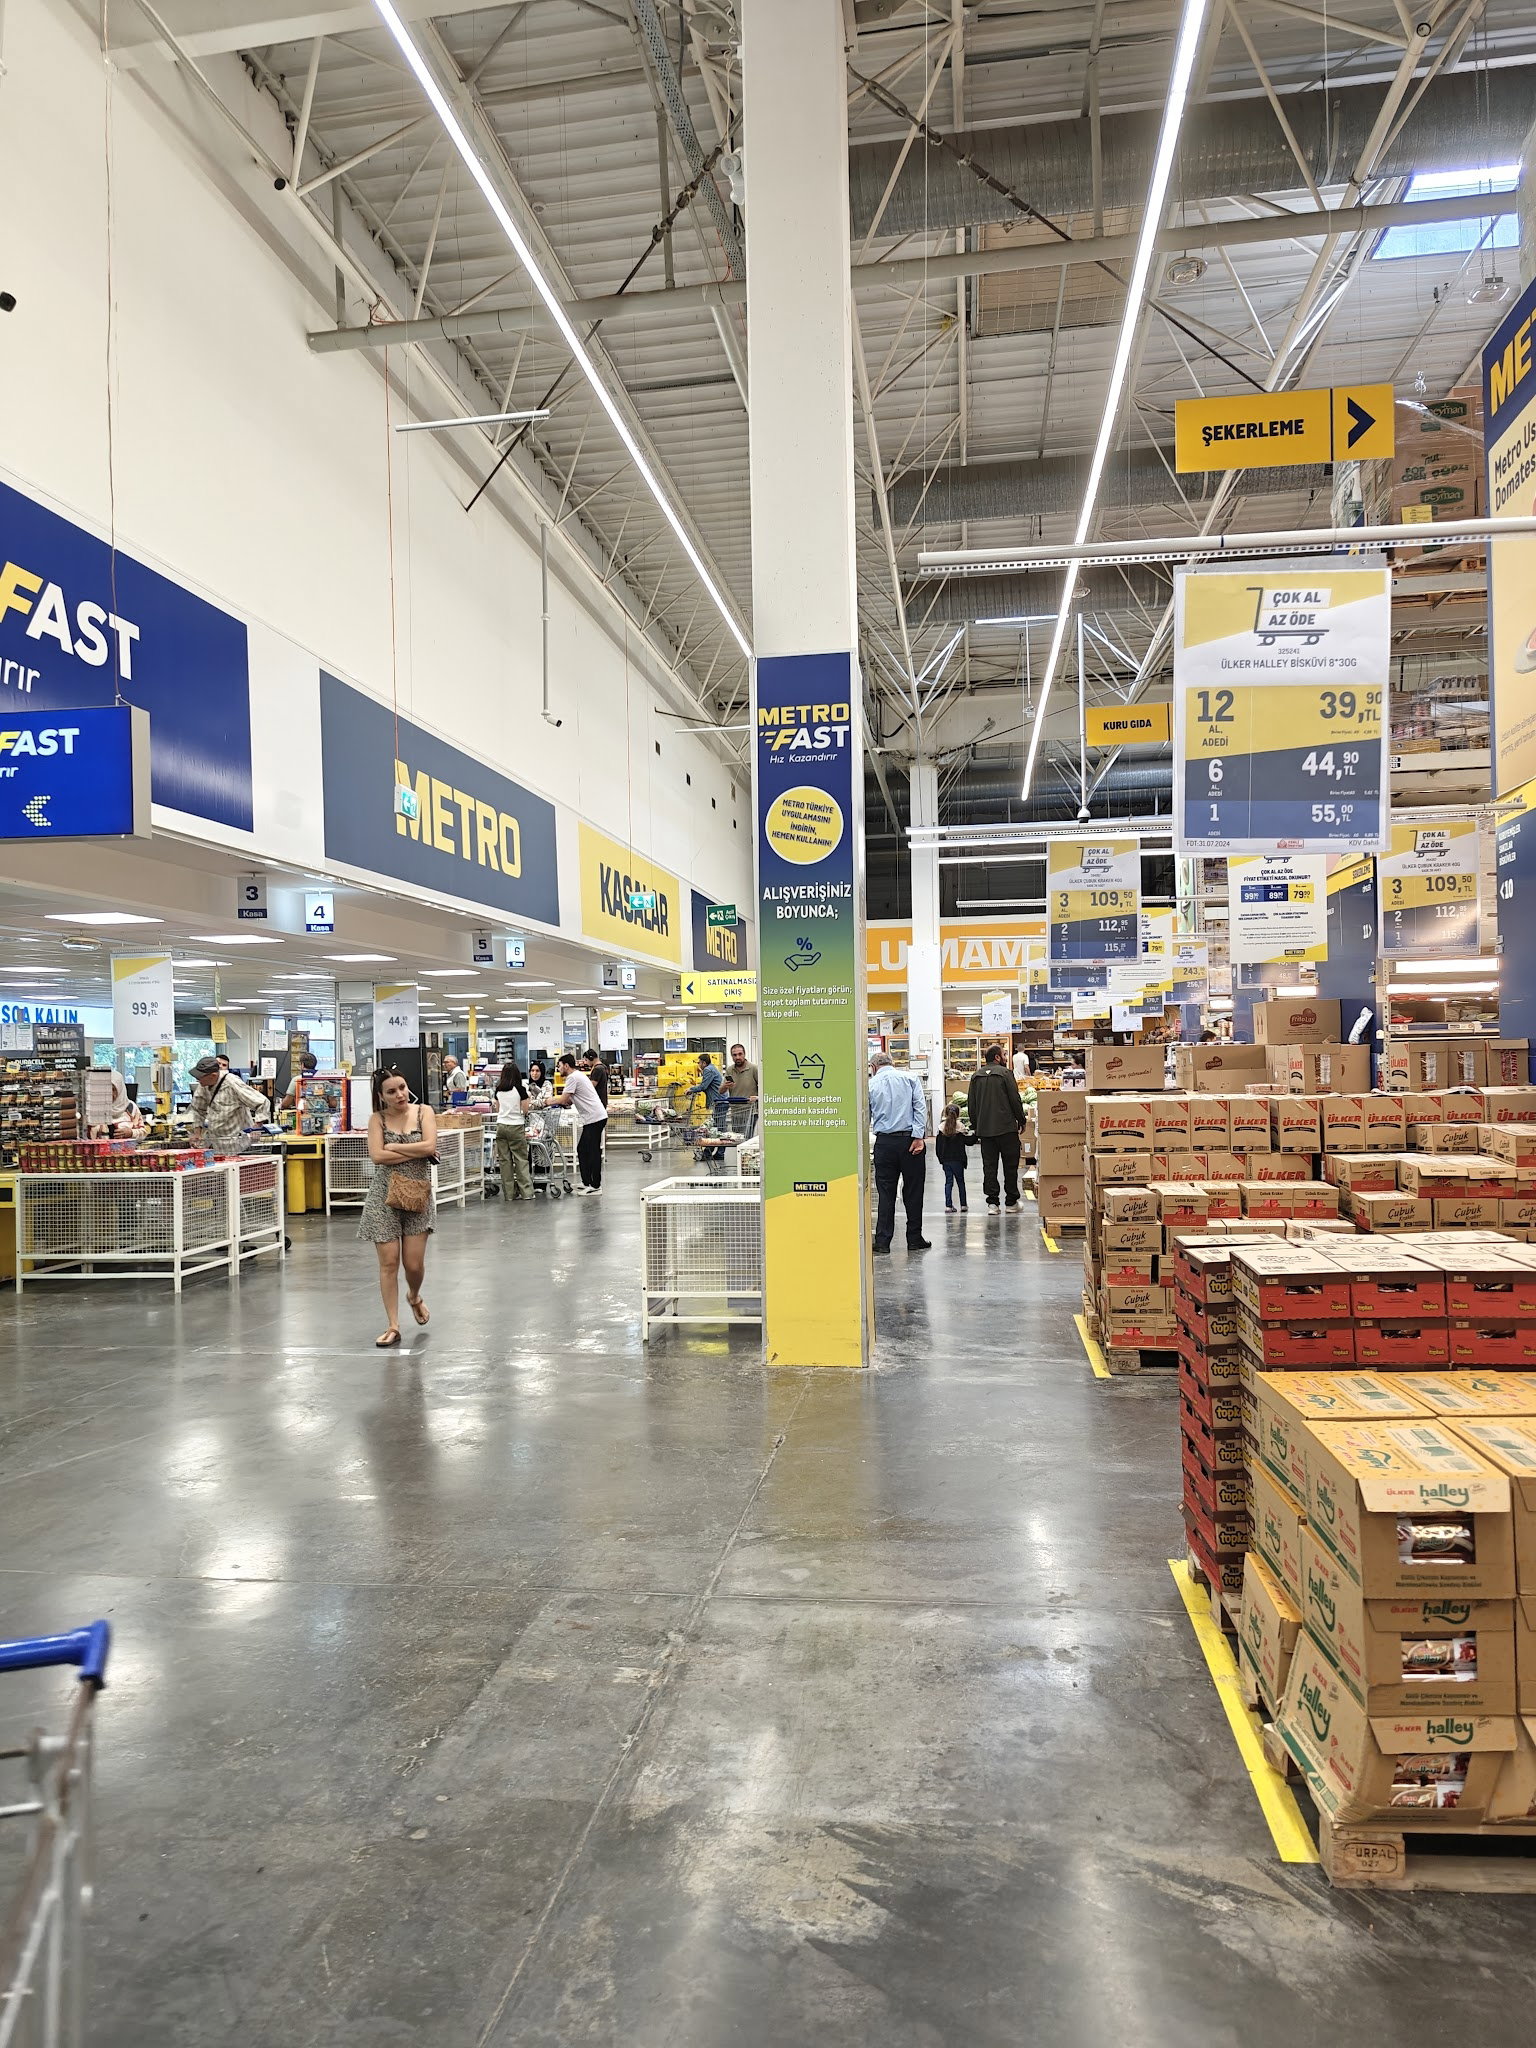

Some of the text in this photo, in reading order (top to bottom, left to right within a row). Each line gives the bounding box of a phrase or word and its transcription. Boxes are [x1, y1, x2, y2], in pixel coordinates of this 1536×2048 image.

[1202, 419, 1304, 447] ŞEKERLEME
[1494, 436, 1522, 484] Metro
[1272, 591, 1321, 607] ÇOK AL
[1269, 610, 1315, 626] AZ ÖDE
[1221, 659, 1251, 670] ÜLKER
[1253, 658, 1288, 669] HALLEY
[1290, 656, 1327, 668] BİSKÜVİ
[1197, 690, 1234, 722] 12
[759, 703, 849, 726] METRO
[1365, 710, 1381, 721] TL
[1103, 719, 1152, 730] KURU GIDA
[1209, 725, 1223, 734] AL.
[771, 726, 849, 751] FAST
[1202, 737, 1229, 747] ADEDİ
[770, 752, 837, 764] Hız Kazandırır
[1208, 759, 1224, 783] 6
[1344, 765, 1356, 776] TL
[783, 799, 834, 814] METRO TÜRKİYE
[1210, 804, 1219, 821] 1
[394, 759, 522, 879] METRO
[782, 810, 831, 824] UYGULAMASINI
[1342, 814, 1351, 822] TL
[772, 831, 832, 847] HEMEN KULLANIN!
[1422, 831, 1437, 839] ÇOK
[1088, 848, 1100, 856] ÇOK
[763, 882, 851, 900] ALIŞVERİŞİNİZ
[1392, 878, 1402, 894] 3
[246, 886, 259, 900] 3
[1060, 893, 1069, 907] 3
[313, 905, 325, 918] 4
[776, 904, 838, 920] BOYUNCA;
[1394, 911, 1402, 922] 2
[1061, 923, 1068, 934] 2
[478, 939, 487, 949] 5
[1062, 943, 1067, 952] 1
[607, 969, 613, 977] 7
[763, 986, 778, 995] Size
[779, 985, 794, 995] özel
[795, 985, 827, 996] fiyatları
[763, 999, 784, 1008] sepet
[785, 998, 811, 1008] toplam
[763, 1009, 801, 1019] takip edin.
[808, 1095, 842, 1105] sepetten
[808, 1106, 838, 1114] kasadan
[798, 1119, 807, 1127] ve
[1100, 1115, 1146, 1129] ÜLKER
[1155, 1117, 1188, 1127] ÜLKER
[1194, 1116, 1227, 1125] ÜLKER
[1233, 1116, 1267, 1126] ÜLKER
[1283, 1116, 1317, 1126] ÜLKER
[1327, 1113, 1362, 1122] ÜLKER
[1368, 1113, 1402, 1122] ÜLKER
[1443, 1131, 1468, 1143] Çubuk
[1112, 1161, 1137, 1174] Çubuk
[1123, 1200, 1148, 1213] Çubuk
[1388, 1205, 1415, 1219] Çubuk
[1120, 1231, 1146, 1244] Çubuk
[1124, 1293, 1150, 1306] Çubuk
[1420, 1484, 1469, 1506] halley
[1422, 1600, 1470, 1625] halley
[1427, 1718, 1473, 1745] halley
